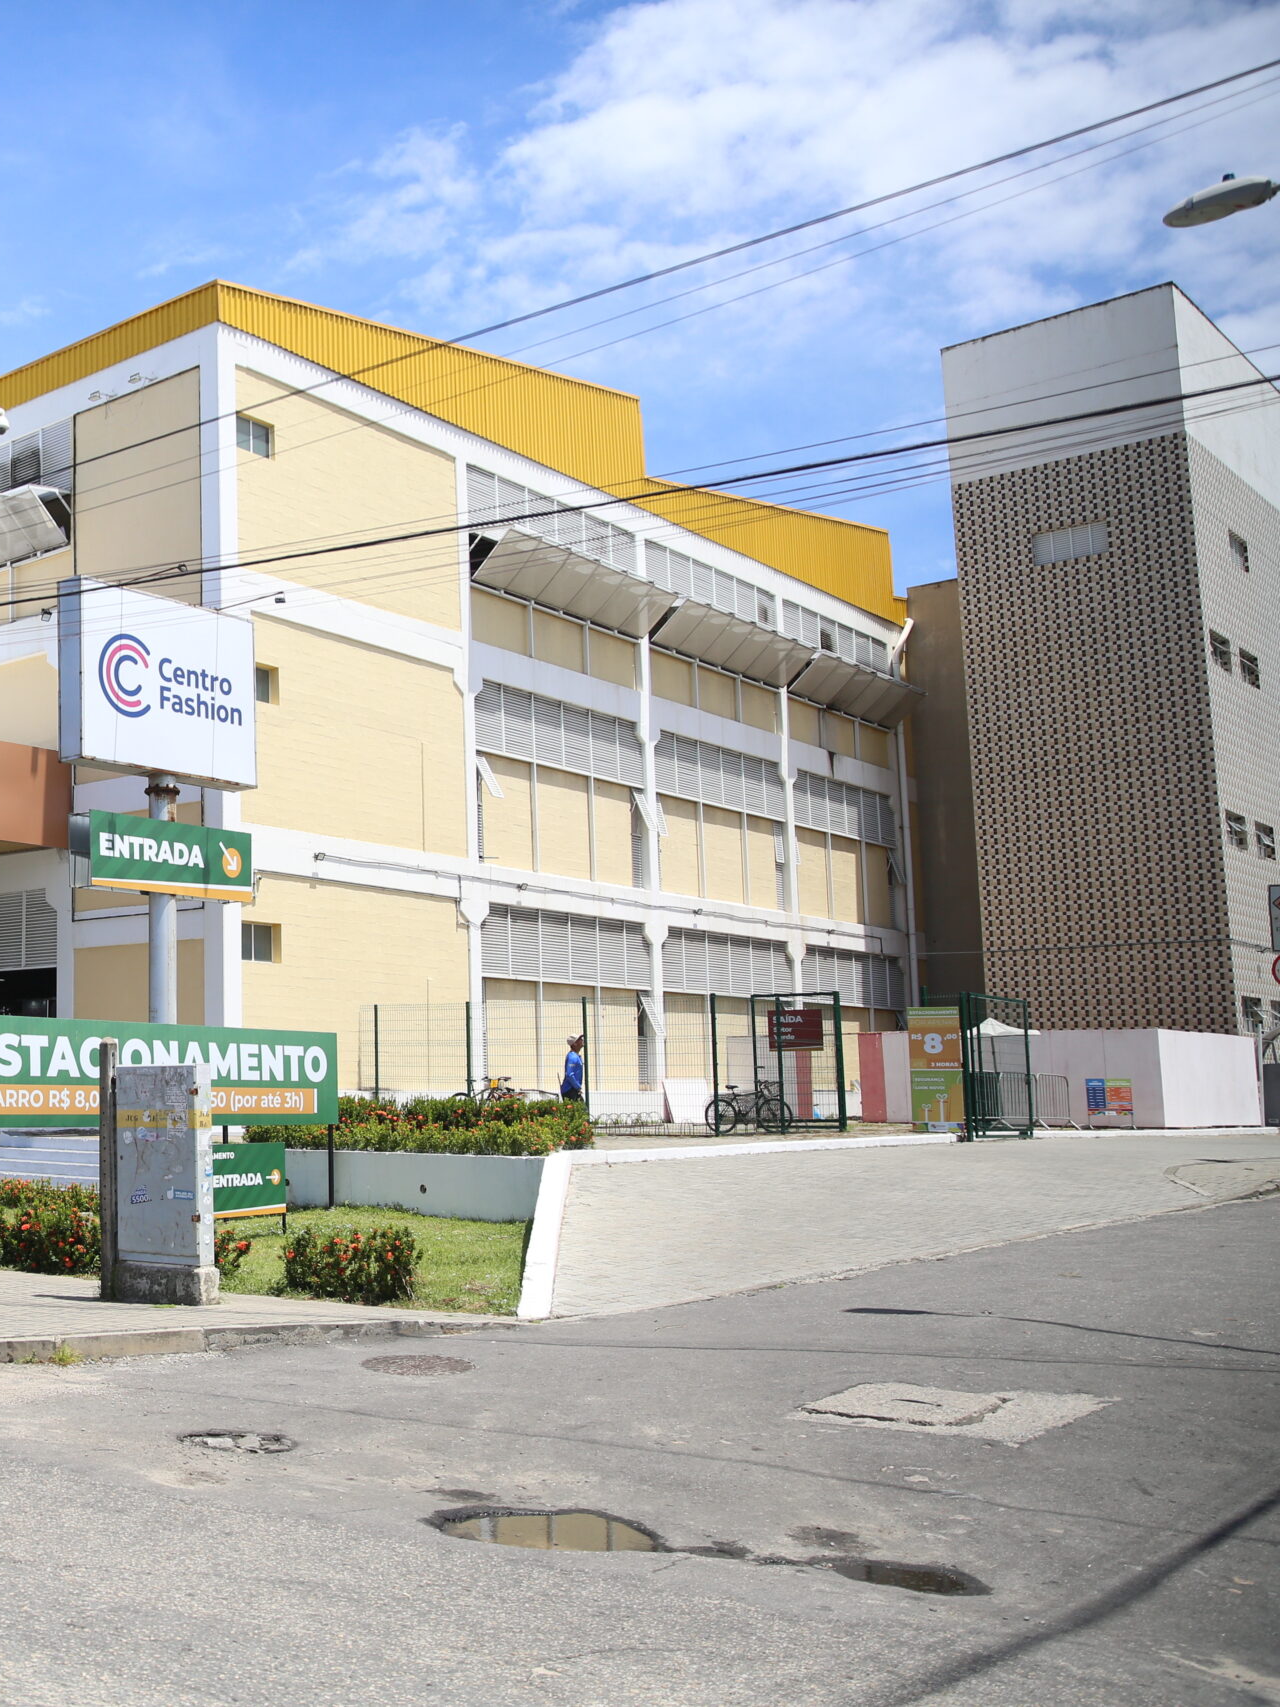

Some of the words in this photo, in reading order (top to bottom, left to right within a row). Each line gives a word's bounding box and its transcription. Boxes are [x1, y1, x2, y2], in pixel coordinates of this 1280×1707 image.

[159, 657, 232, 696] Centro
[160, 685, 243, 727] Fashion
[99, 832, 205, 868] ENTRADA
[48, 1088, 70, 1110] R$
[230, 1091, 257, 1113] (por
[260, 1091, 281, 1108] até
[284, 1091, 304, 1112] 3h)
[213, 1172, 263, 1188] ENTRADA
